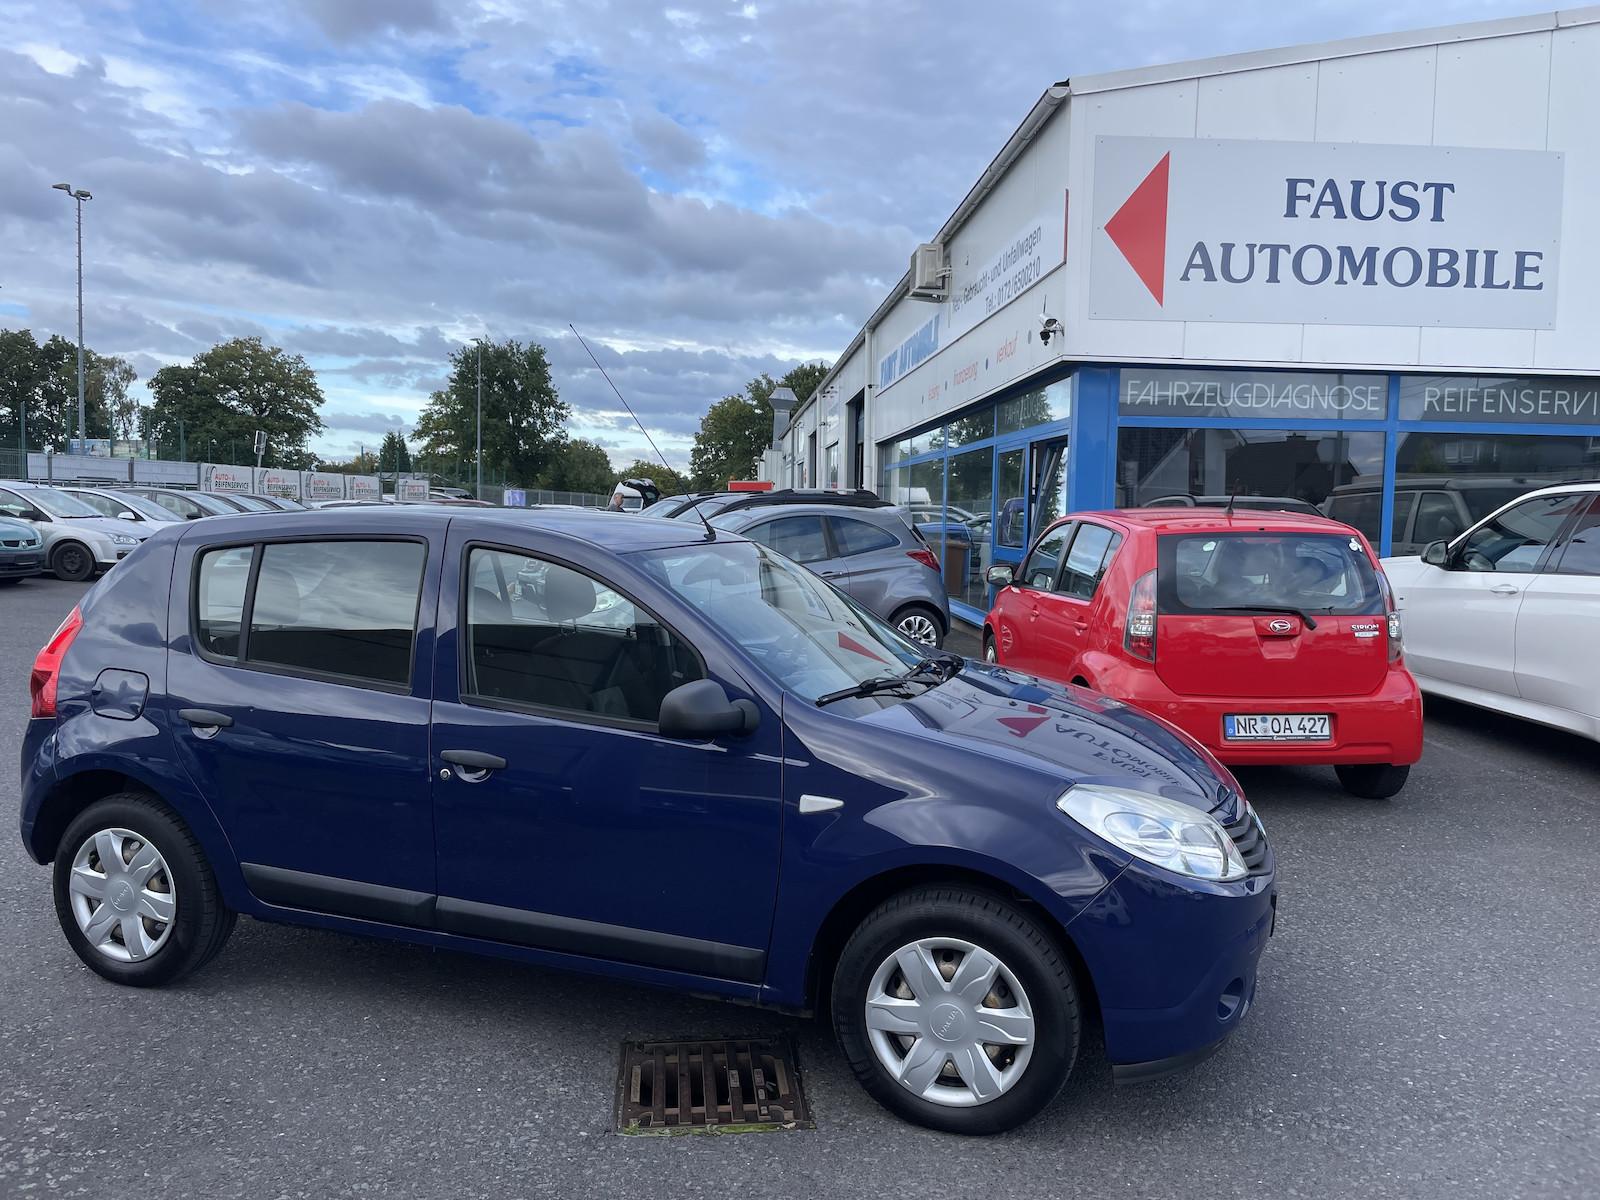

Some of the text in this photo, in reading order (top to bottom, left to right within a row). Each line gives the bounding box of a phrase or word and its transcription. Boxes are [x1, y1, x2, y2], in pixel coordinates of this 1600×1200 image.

[1283, 178, 1456, 222] FAUST
[1003, 226, 1042, 273] Unfallwagen
[1179, 241, 1545, 290] AUTOMOBILE
[1127, 380, 1382, 411] FAHRZEUGDIAGNOSE
[214, 480, 249, 489] REIFENSERVICE
[1236, 717, 1327, 734] NR OA 427
